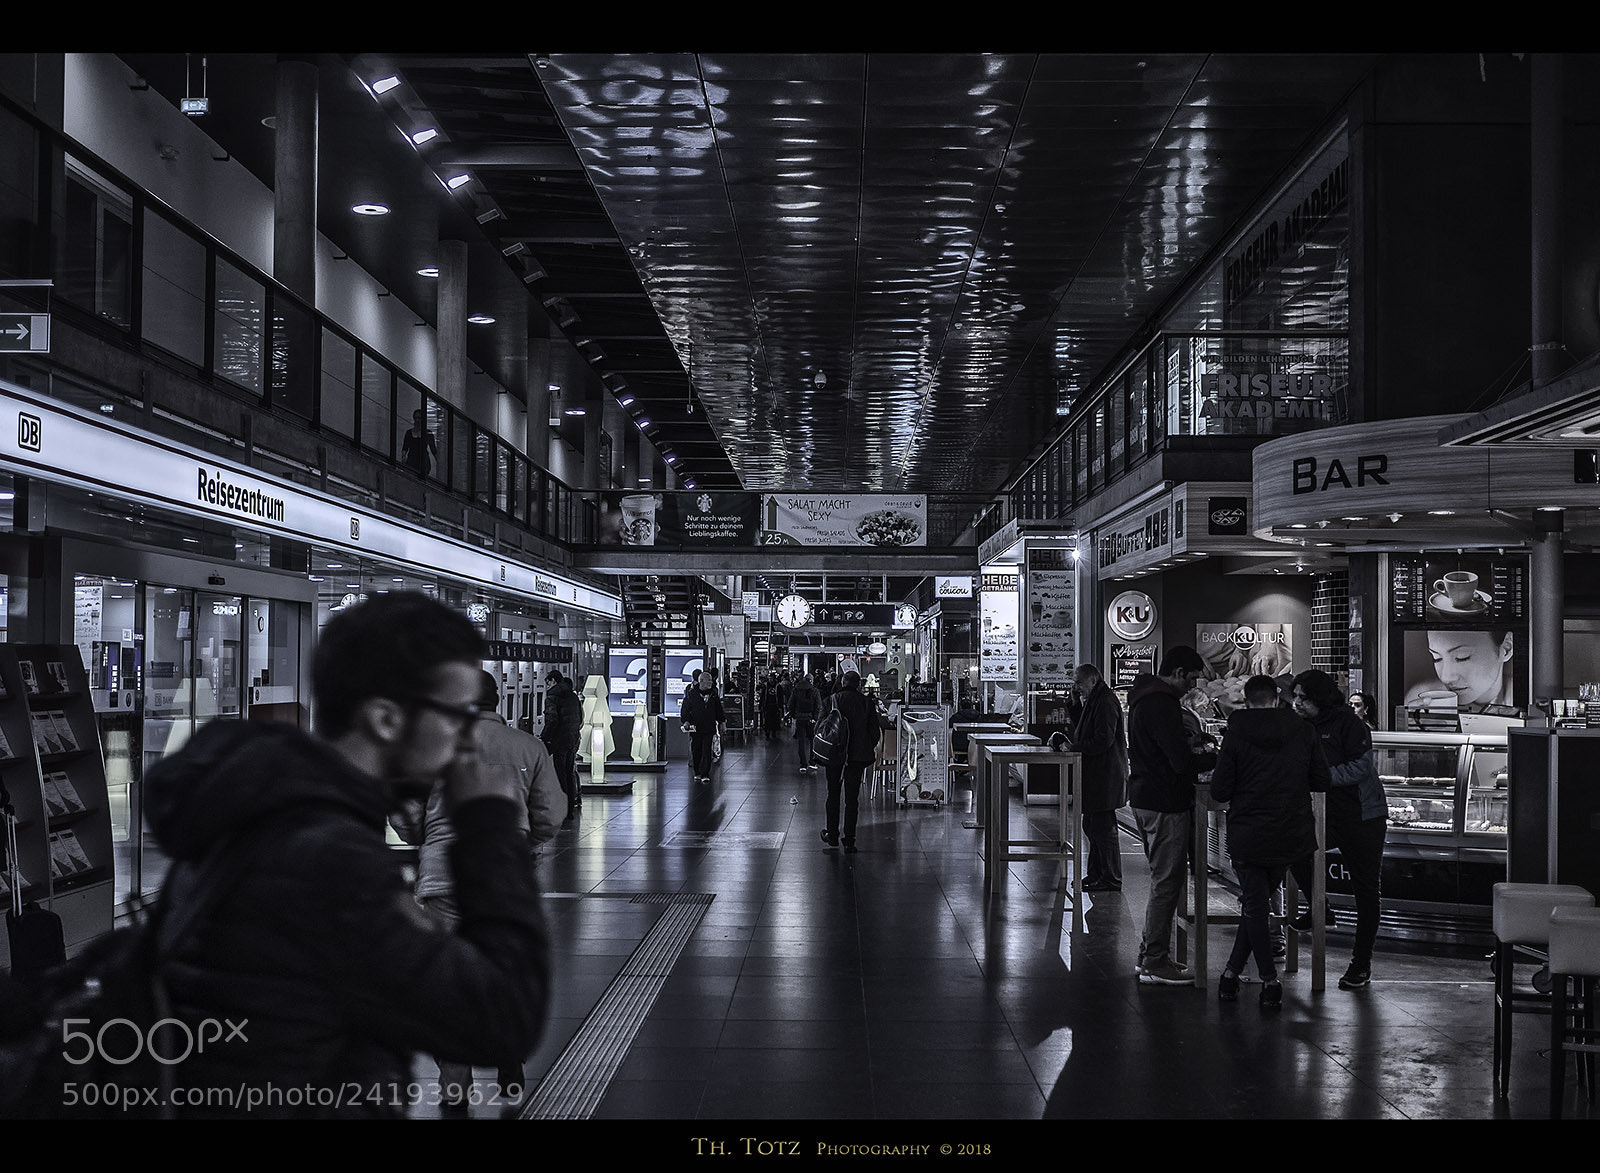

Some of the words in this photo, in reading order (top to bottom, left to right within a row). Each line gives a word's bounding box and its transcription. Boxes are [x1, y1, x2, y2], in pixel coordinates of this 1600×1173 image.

[1226, 220, 1279, 306] FRISEUR
[1224, 355, 1258, 363] BILDEN
[1260, 355, 1314, 363] LEHRLINGE
[1316, 355, 1336, 363] AUS
[1200, 373, 1334, 398] FRISEUR
[1199, 400, 1335, 418] AKADEMIE
[20, 415, 40, 449] DB
[1292, 454, 1390, 495] BAR
[197, 467, 285, 523] Reisezentrum
[788, 499, 816, 510] SALAT
[817, 499, 852, 510] MACHT
[717, 515, 742, 524] wenige
[807, 511, 832, 522] SEXY
[684, 522, 710, 530] Schritte
[688, 530, 739, 539] Lieblingskaffee.
[765, 533, 783, 545] 25
[1116, 606, 1149, 623] K&U
